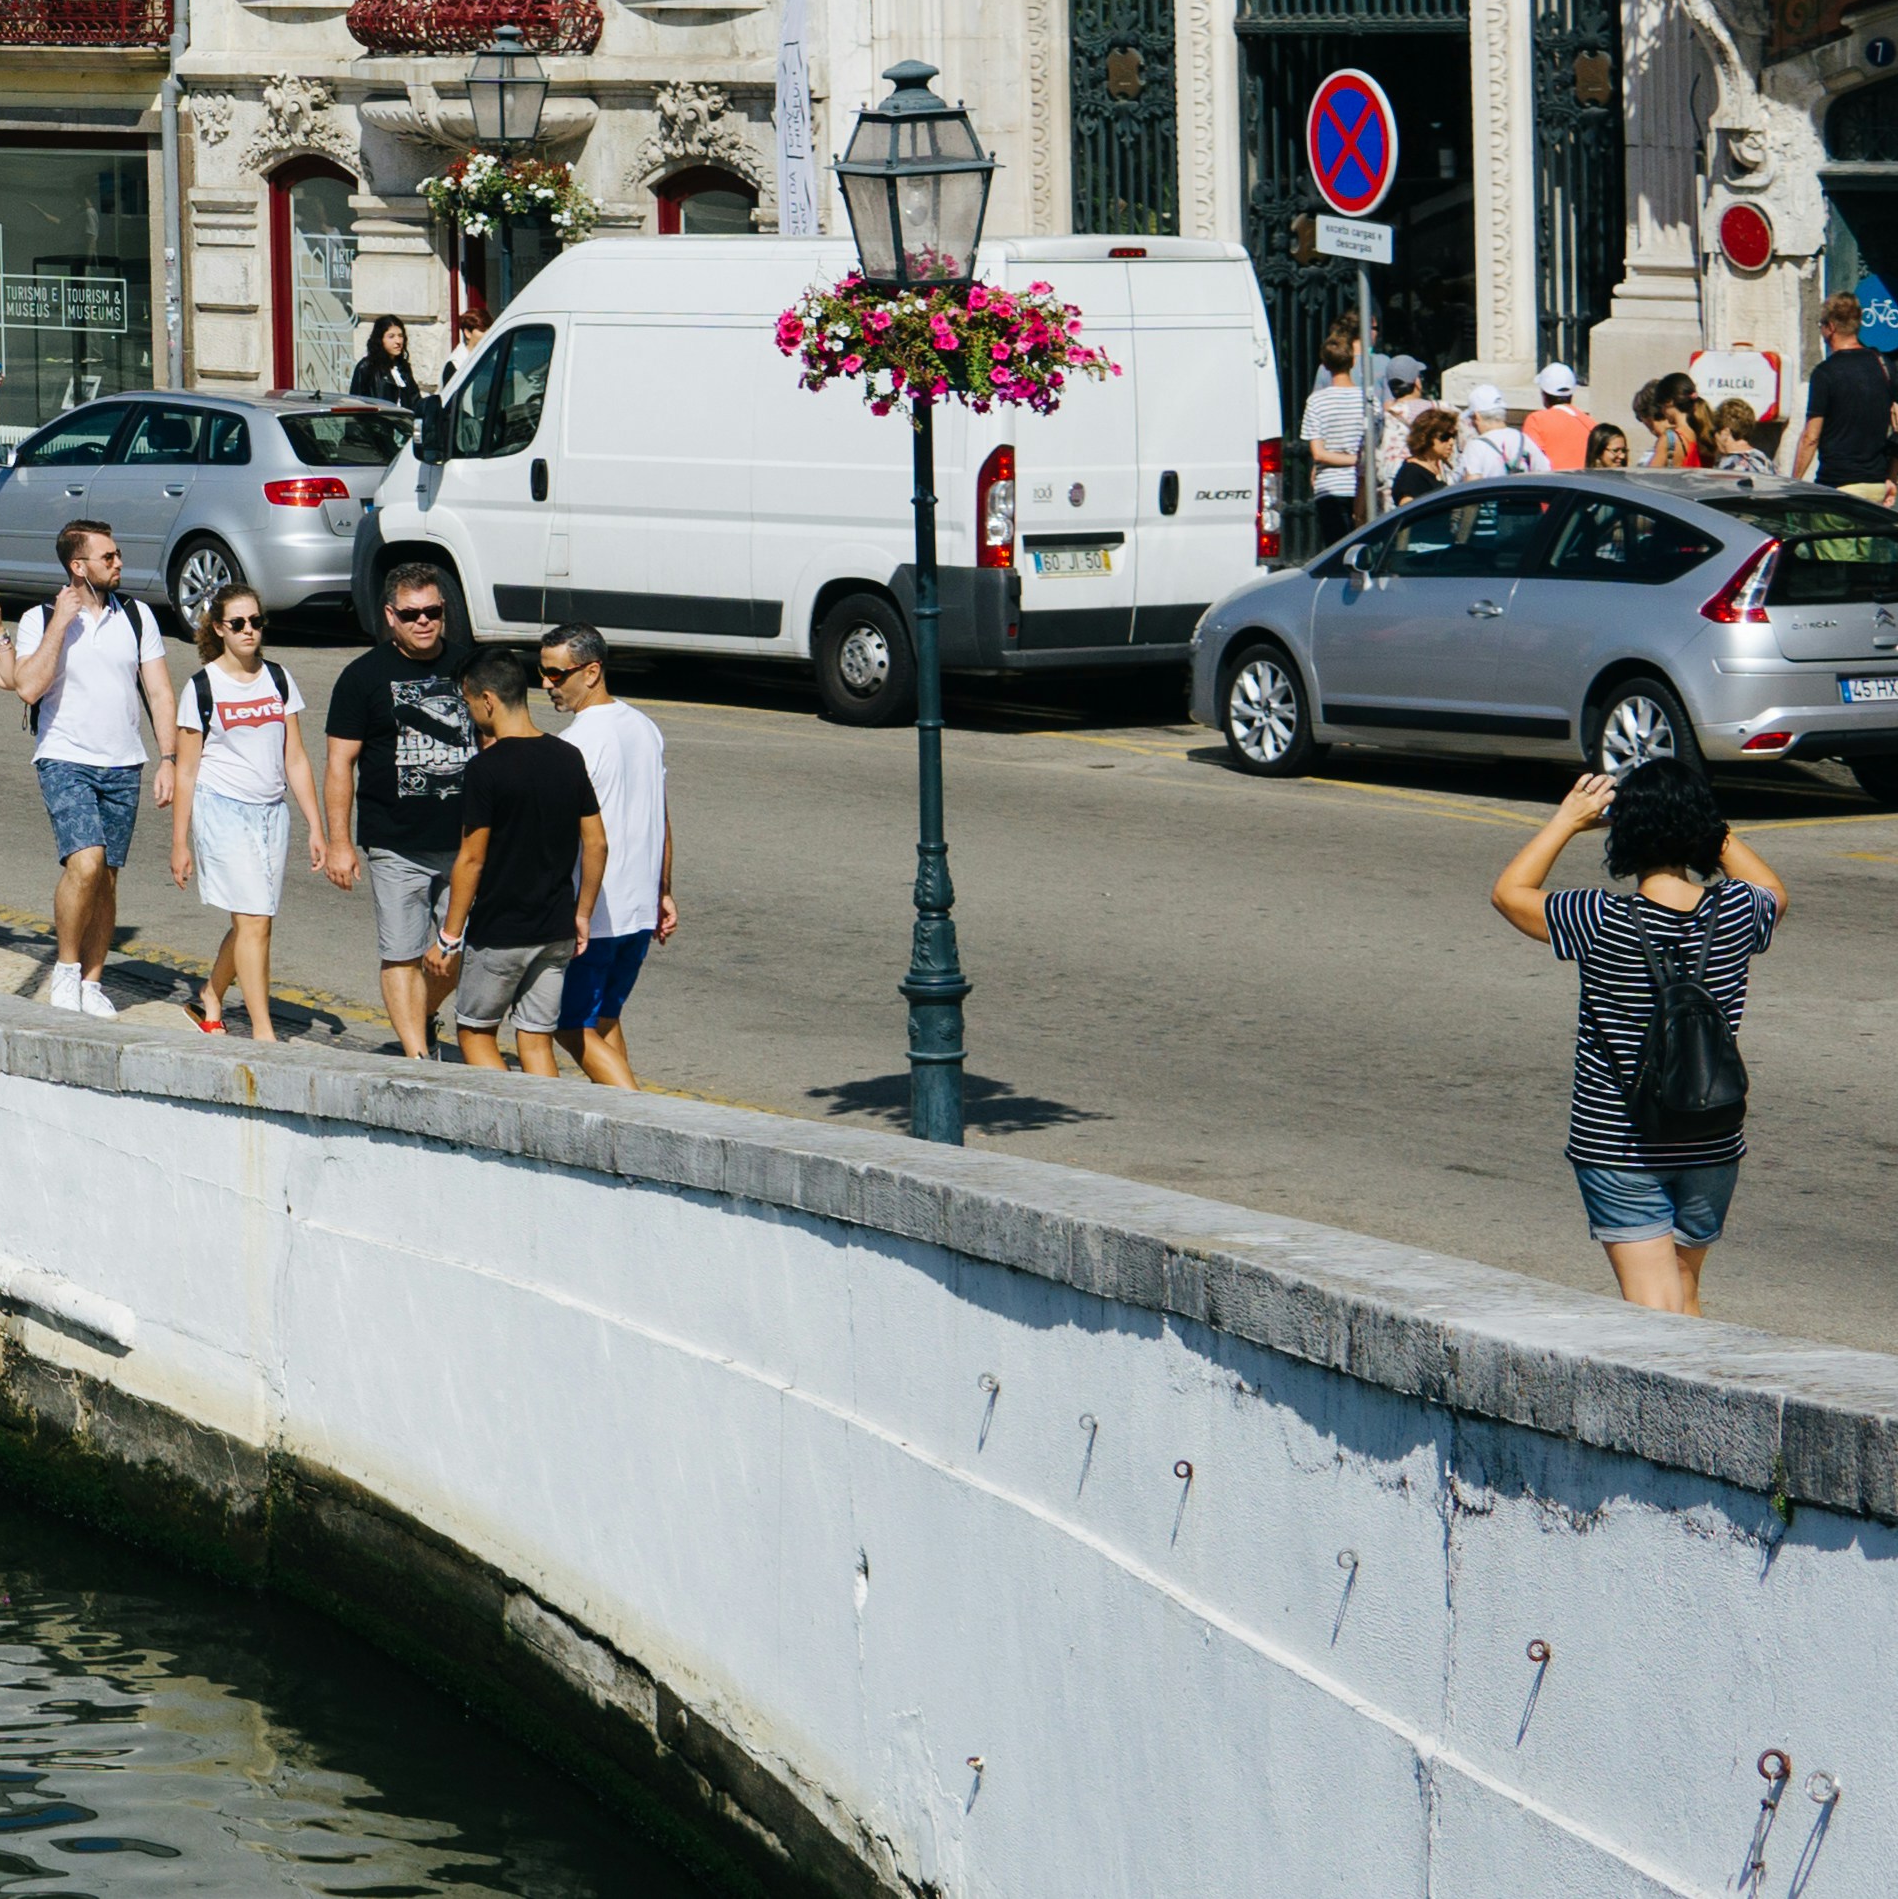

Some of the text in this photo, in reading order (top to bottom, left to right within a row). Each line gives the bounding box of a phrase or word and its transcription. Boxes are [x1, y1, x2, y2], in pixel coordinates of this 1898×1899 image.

[332, 264, 352, 279] NOV
[6, 285, 48, 302] TURISMO
[51, 287, 58, 302] E
[67, 287, 110, 305] TOURISM
[114, 291, 122, 305] &
[6, 302, 122, 321] MUSEUS MUSEUMS
[1195, 489, 1252, 501] DUCATO
